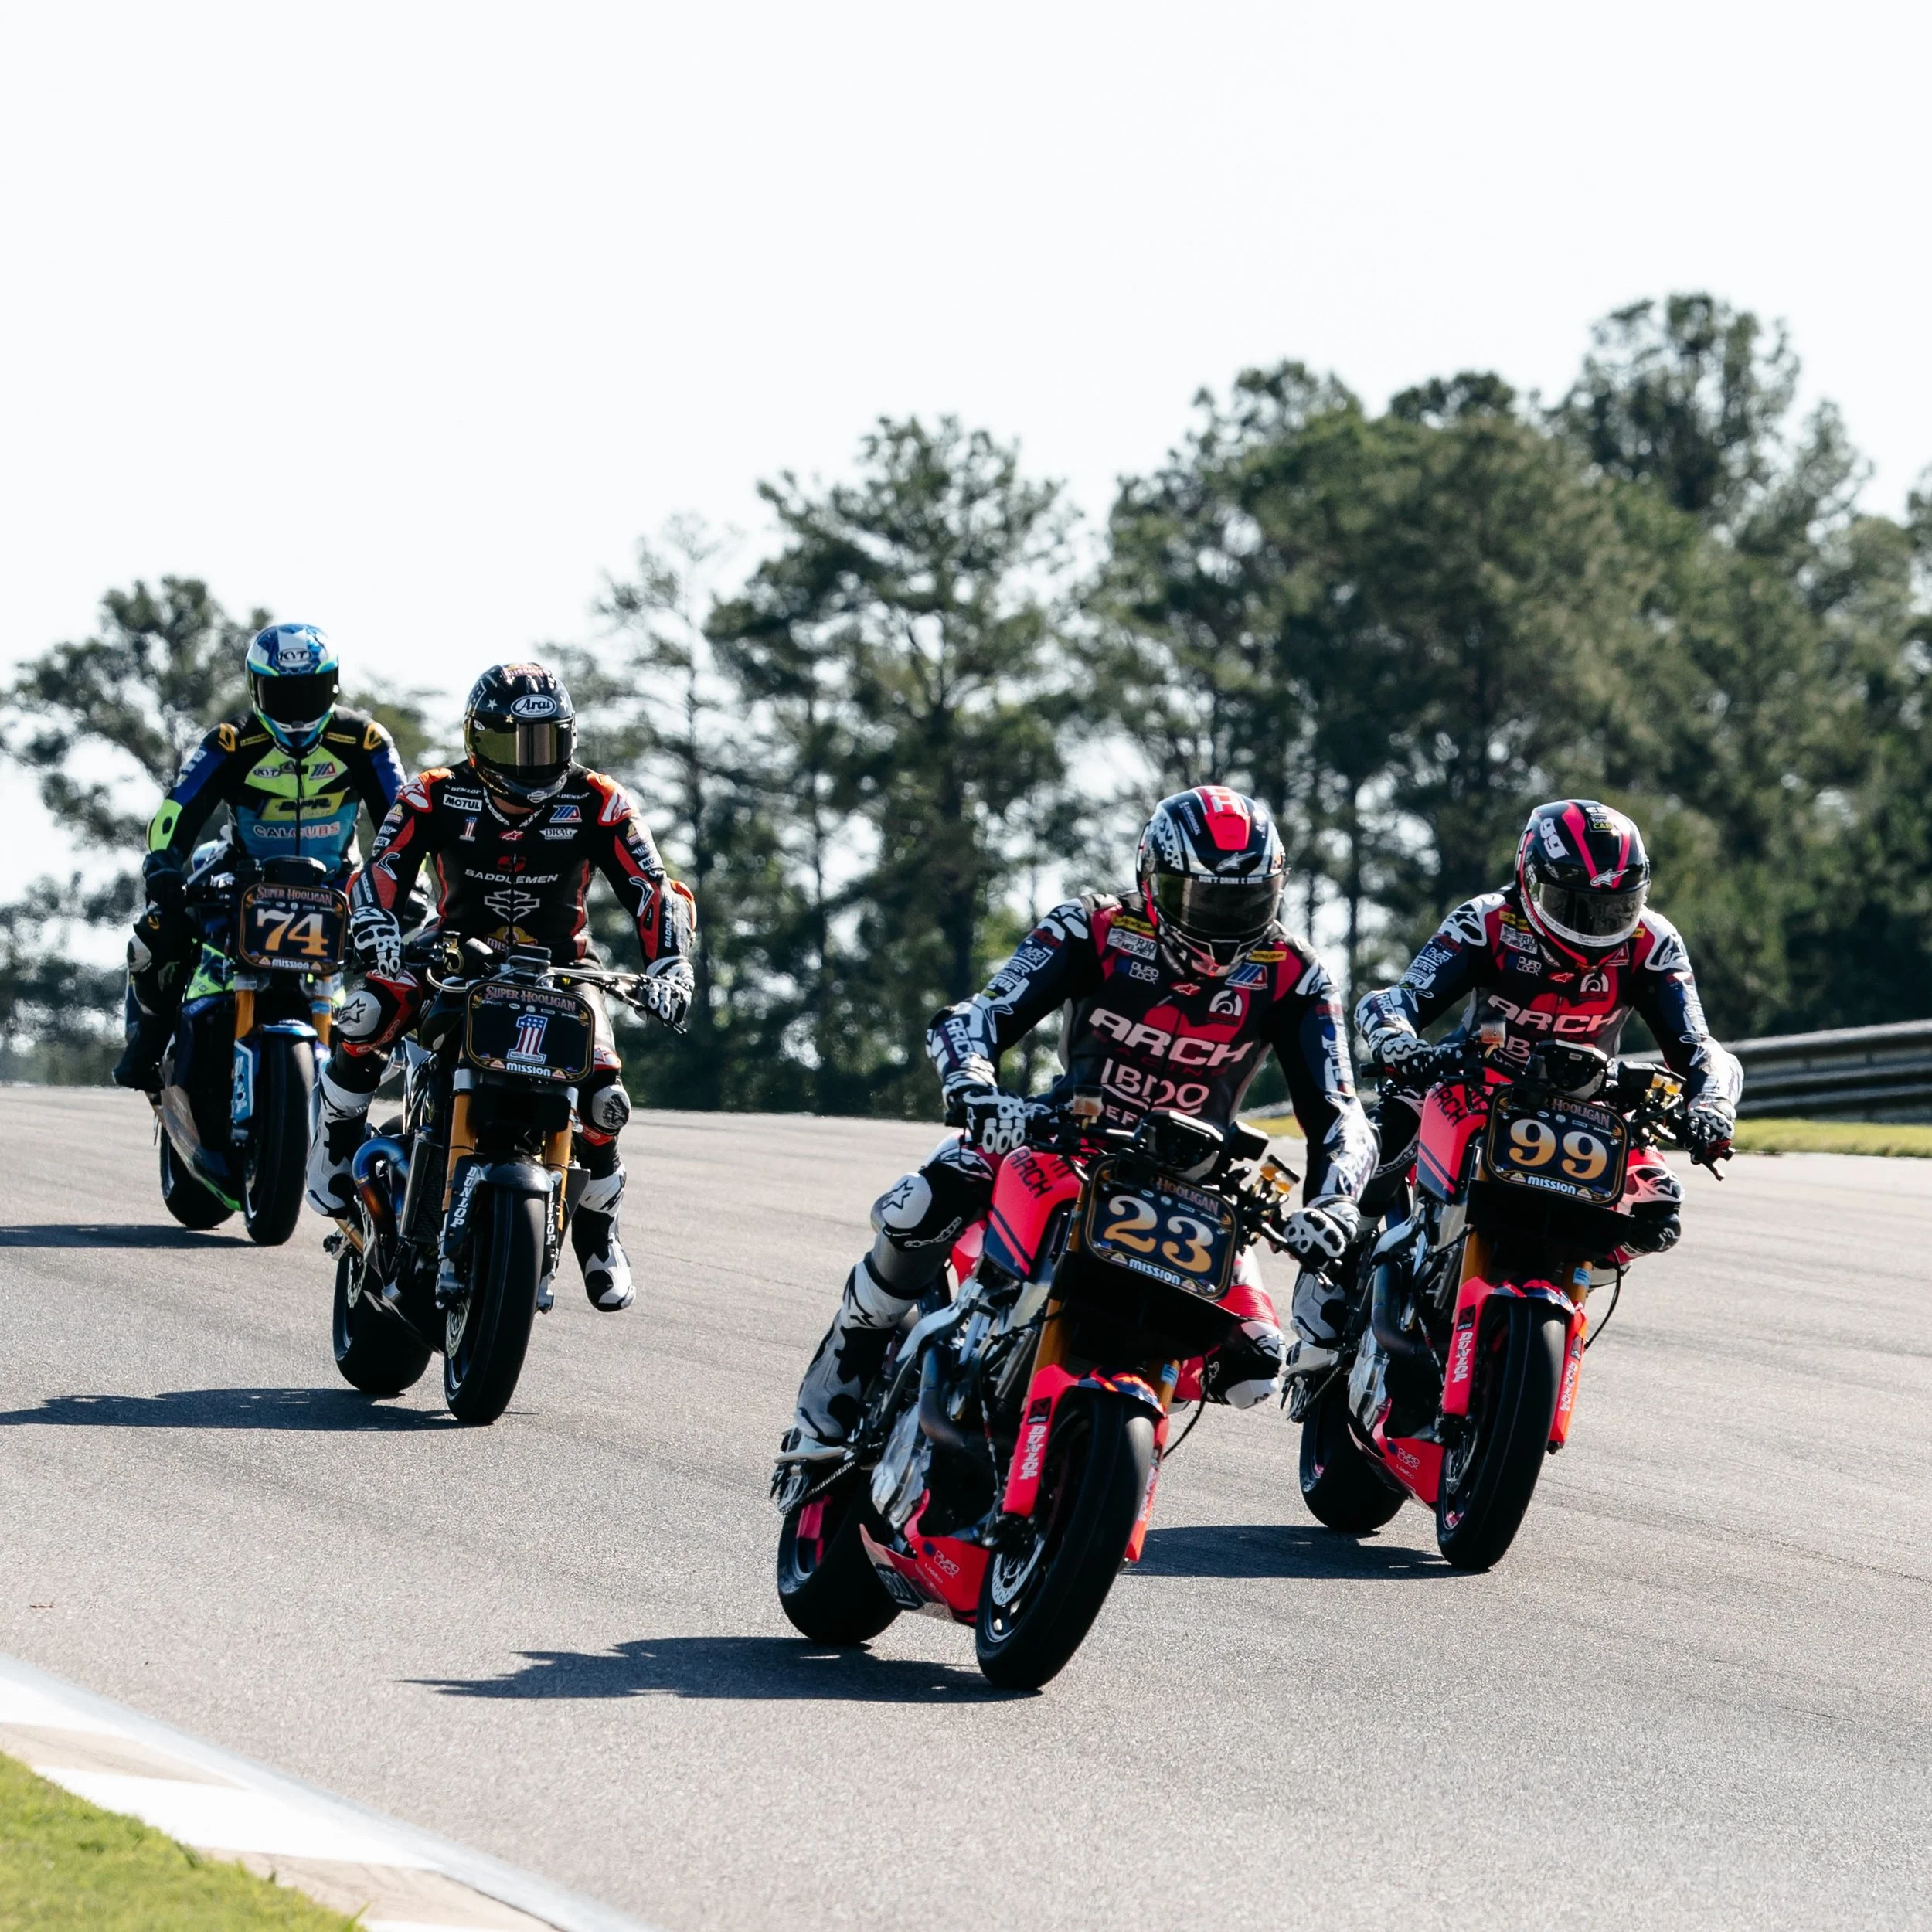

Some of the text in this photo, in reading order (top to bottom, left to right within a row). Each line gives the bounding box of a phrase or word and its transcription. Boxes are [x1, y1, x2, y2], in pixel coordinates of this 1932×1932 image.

[519, 698, 551, 711] Arai
[445, 796, 481, 810] MOTUL
[256, 885, 332, 906] SUPER HOOLIGAN
[465, 869, 559, 885] SADDLEMEN
[257, 908, 329, 957] 74
[271, 958, 310, 970] mission
[484, 985, 576, 1012] SUPER HOOLIGAN
[1488, 995, 1623, 1033] ARCH
[506, 1013, 548, 1065] 1
[1089, 1007, 1254, 1067] ARCH
[505, 1062, 551, 1077] mission
[1551, 1097, 1610, 1129] HOOLIGAN
[1509, 1118, 1607, 1180] 99
[1008, 1149, 1054, 1199] ARCH
[1527, 1175, 1577, 1196] mission
[450, 1166, 478, 1228] DUNLOP
[1156, 1175, 1220, 1216] HOOLIGAN
[546, 1191, 556, 1246] UNLOP
[1103, 1195, 1213, 1274] 23
[1128, 1258, 1181, 1286] mission
[1452, 1332, 1473, 1383] DUNLOP
[1019, 1424, 1047, 1481] DUNLOP
